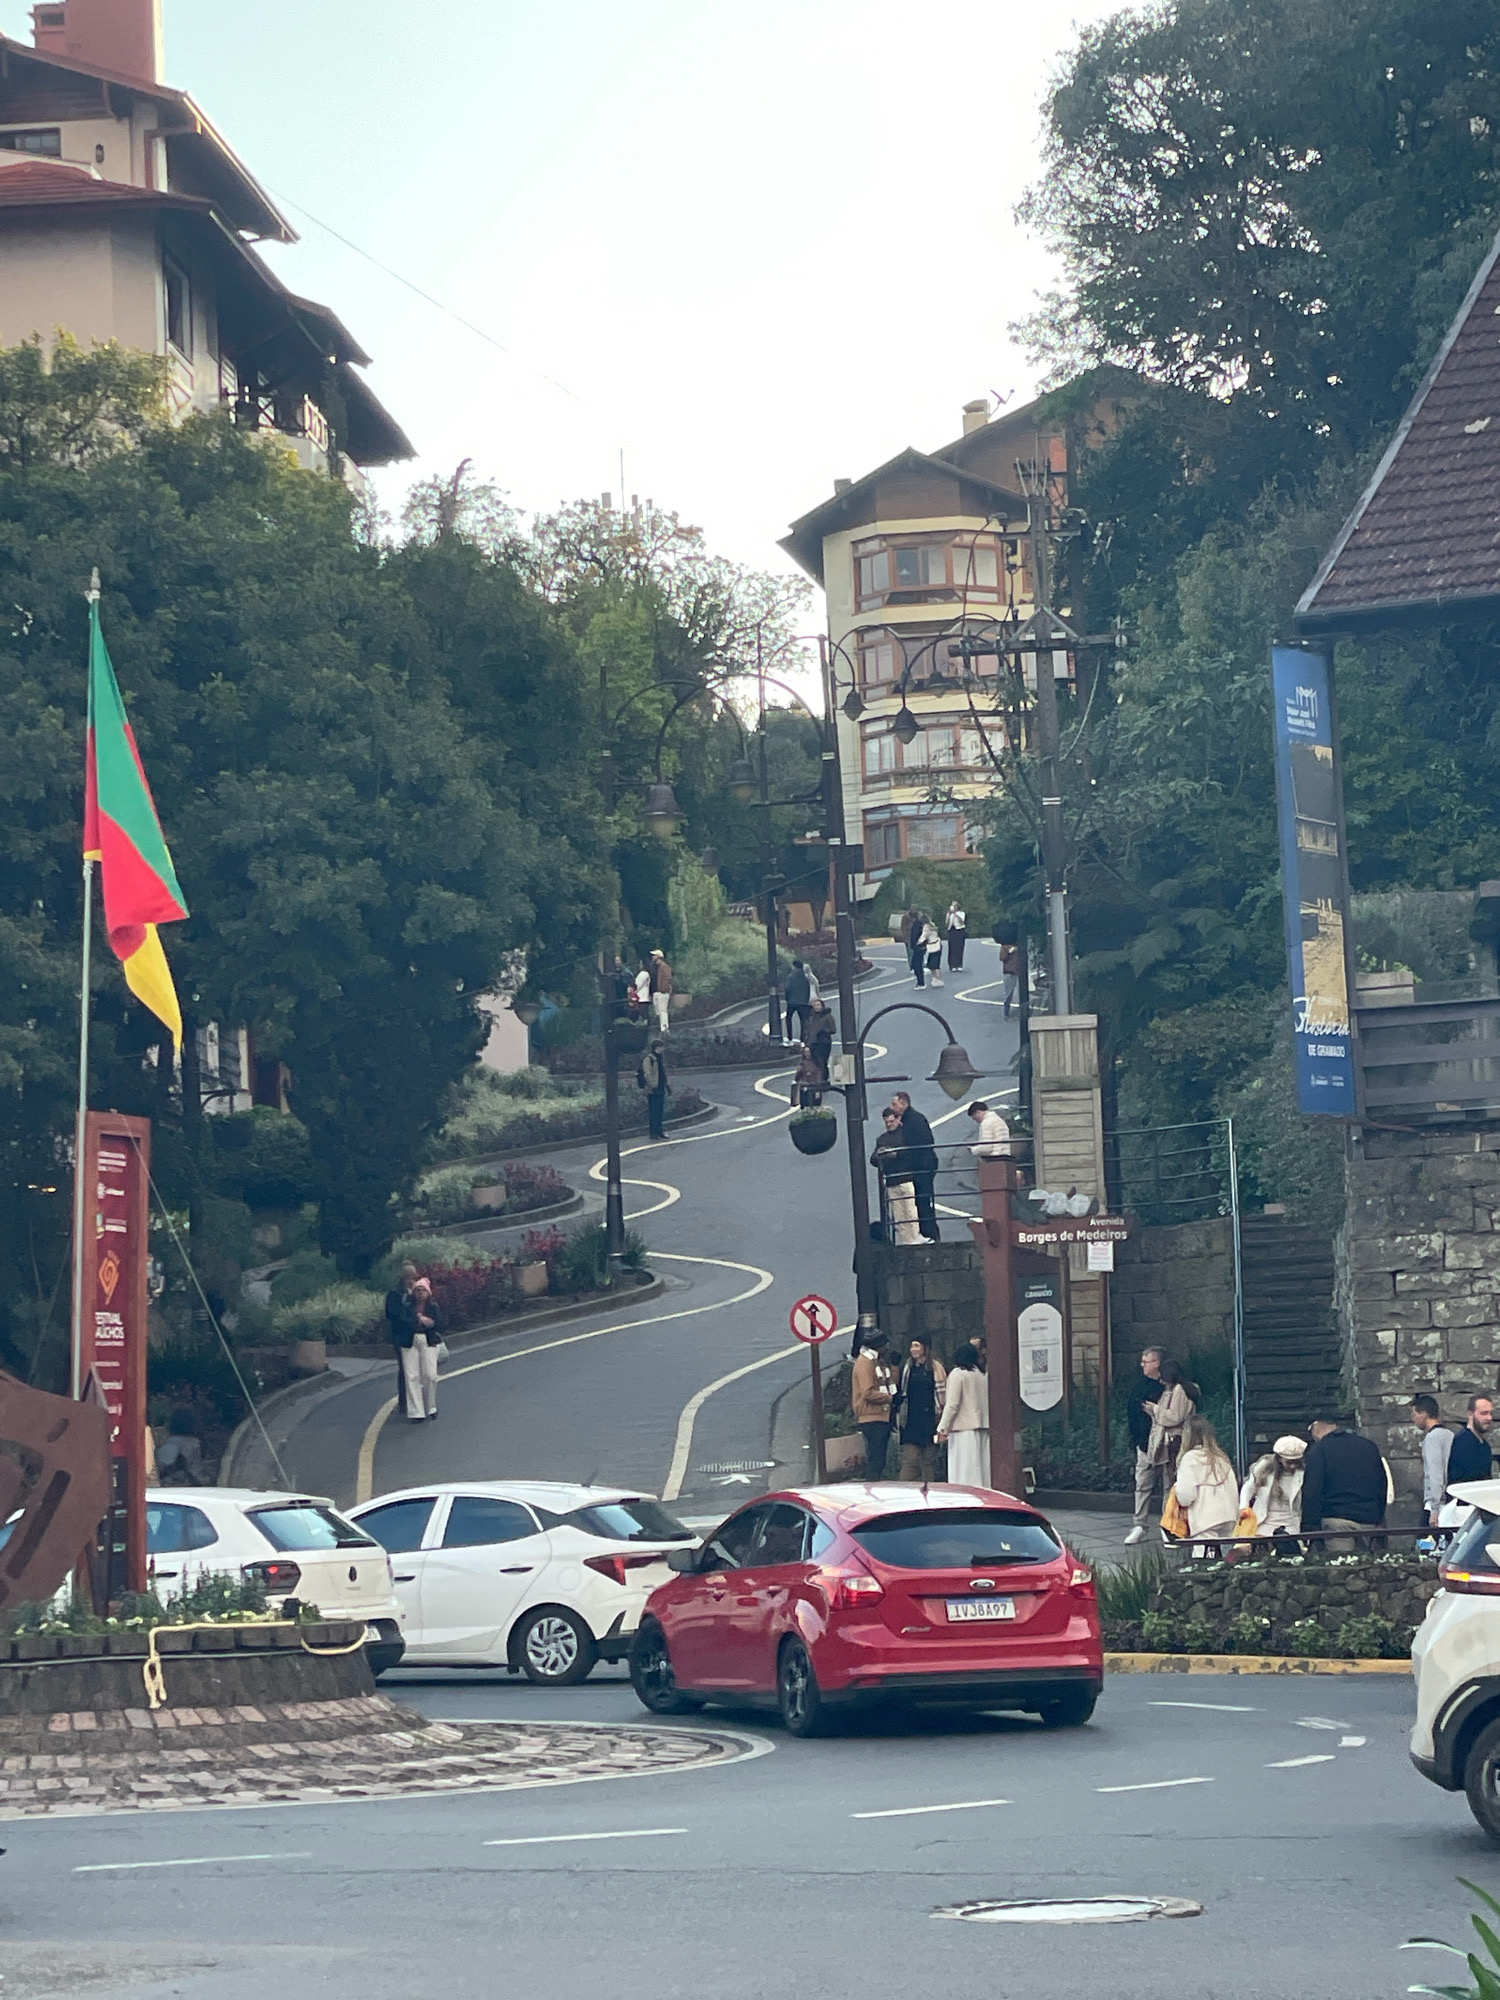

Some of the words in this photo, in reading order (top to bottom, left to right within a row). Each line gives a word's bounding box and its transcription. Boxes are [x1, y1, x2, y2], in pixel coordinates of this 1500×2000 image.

[1090, 1217, 1125, 1226] Avenida
[1018, 1232, 1057, 1244] Borges
[1060, 1230, 1074, 1241] de
[1076, 1229, 1127, 1240] Medeiros
[954, 1603, 1008, 1618] IVJ8A97
